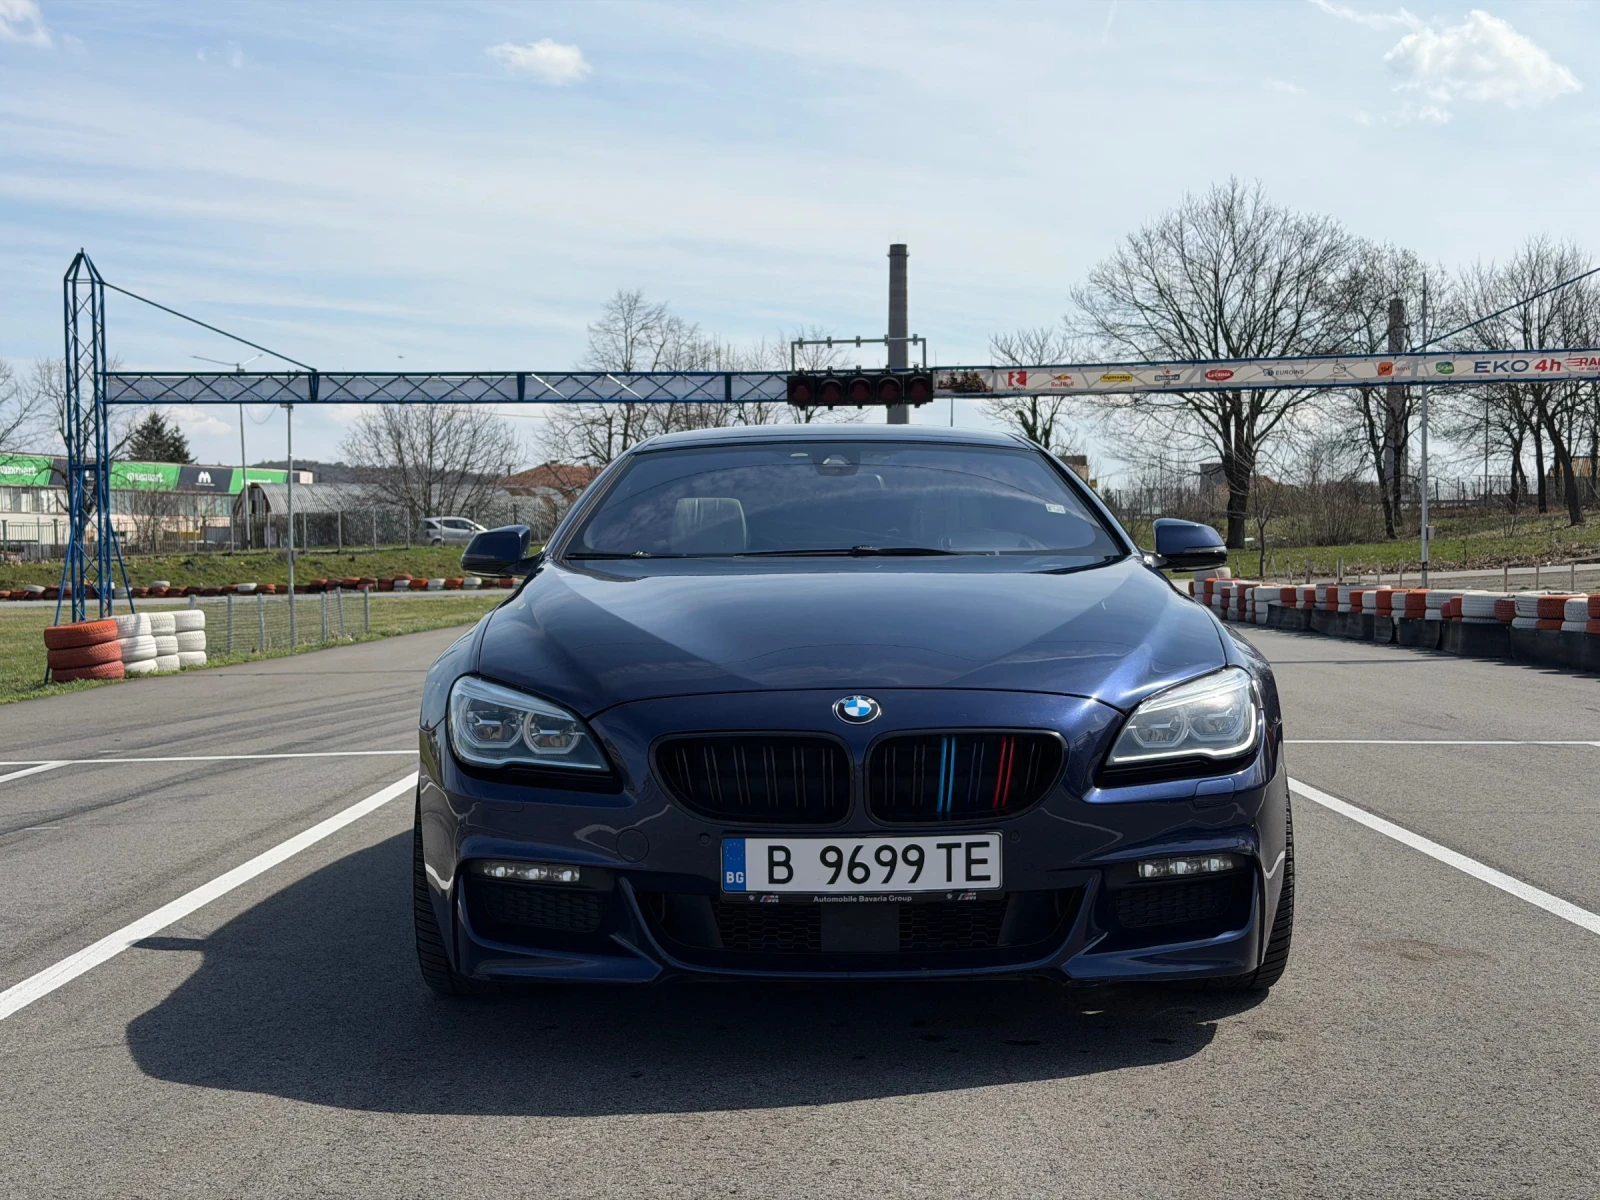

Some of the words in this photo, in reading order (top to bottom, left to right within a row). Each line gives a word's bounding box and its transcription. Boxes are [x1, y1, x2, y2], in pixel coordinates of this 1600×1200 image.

[1473, 358, 1530, 374] EKO
[1534, 358, 1562, 372] 4h
[767, 845, 794, 885] B
[725, 871, 745, 884] BG
[812, 895, 857, 903] Automobile
[888, 895, 912, 903] Group
